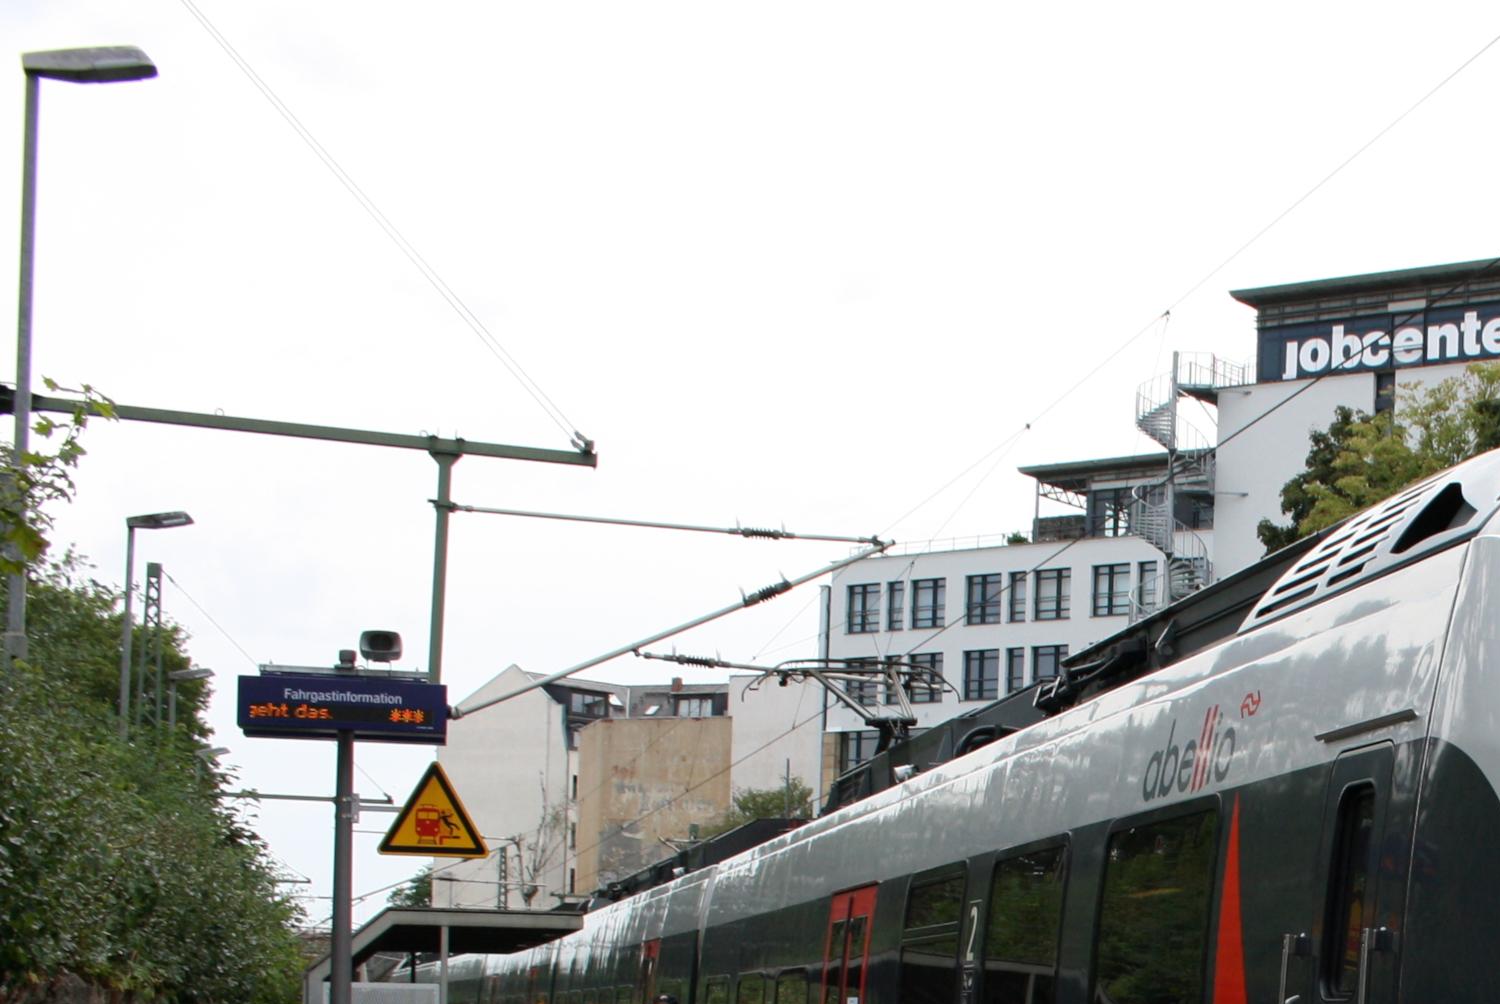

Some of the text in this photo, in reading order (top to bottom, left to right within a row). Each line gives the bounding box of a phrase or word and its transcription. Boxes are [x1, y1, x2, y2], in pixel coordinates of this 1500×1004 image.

[283, 687, 403, 706] Fahrgastinformation
[1142, 704, 1236, 802] abellio
[965, 905, 978, 961] 2
